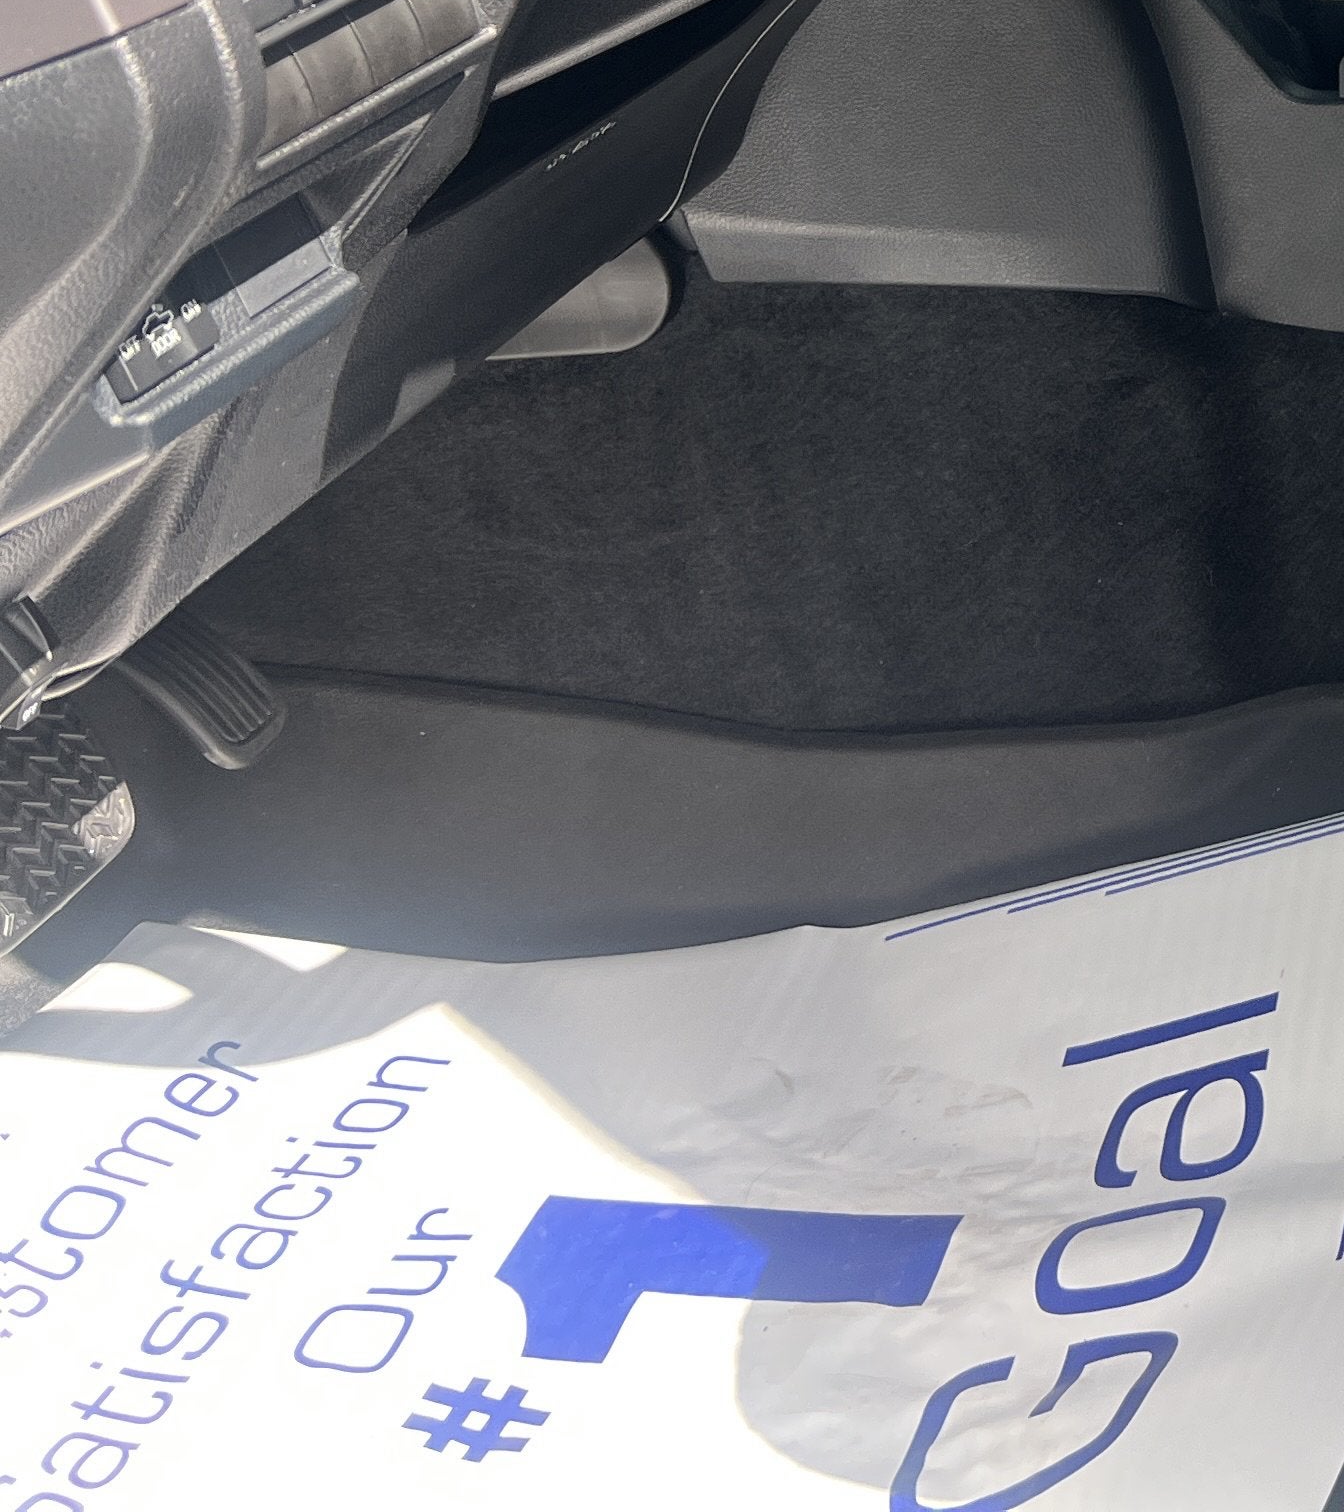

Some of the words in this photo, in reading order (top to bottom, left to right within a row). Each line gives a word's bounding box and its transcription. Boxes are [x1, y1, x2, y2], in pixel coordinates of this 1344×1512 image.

[0, 1055, 451, 1512] atisfaction
[294, 1207, 473, 1374] Our
[888, 991, 1279, 1512] Goal
